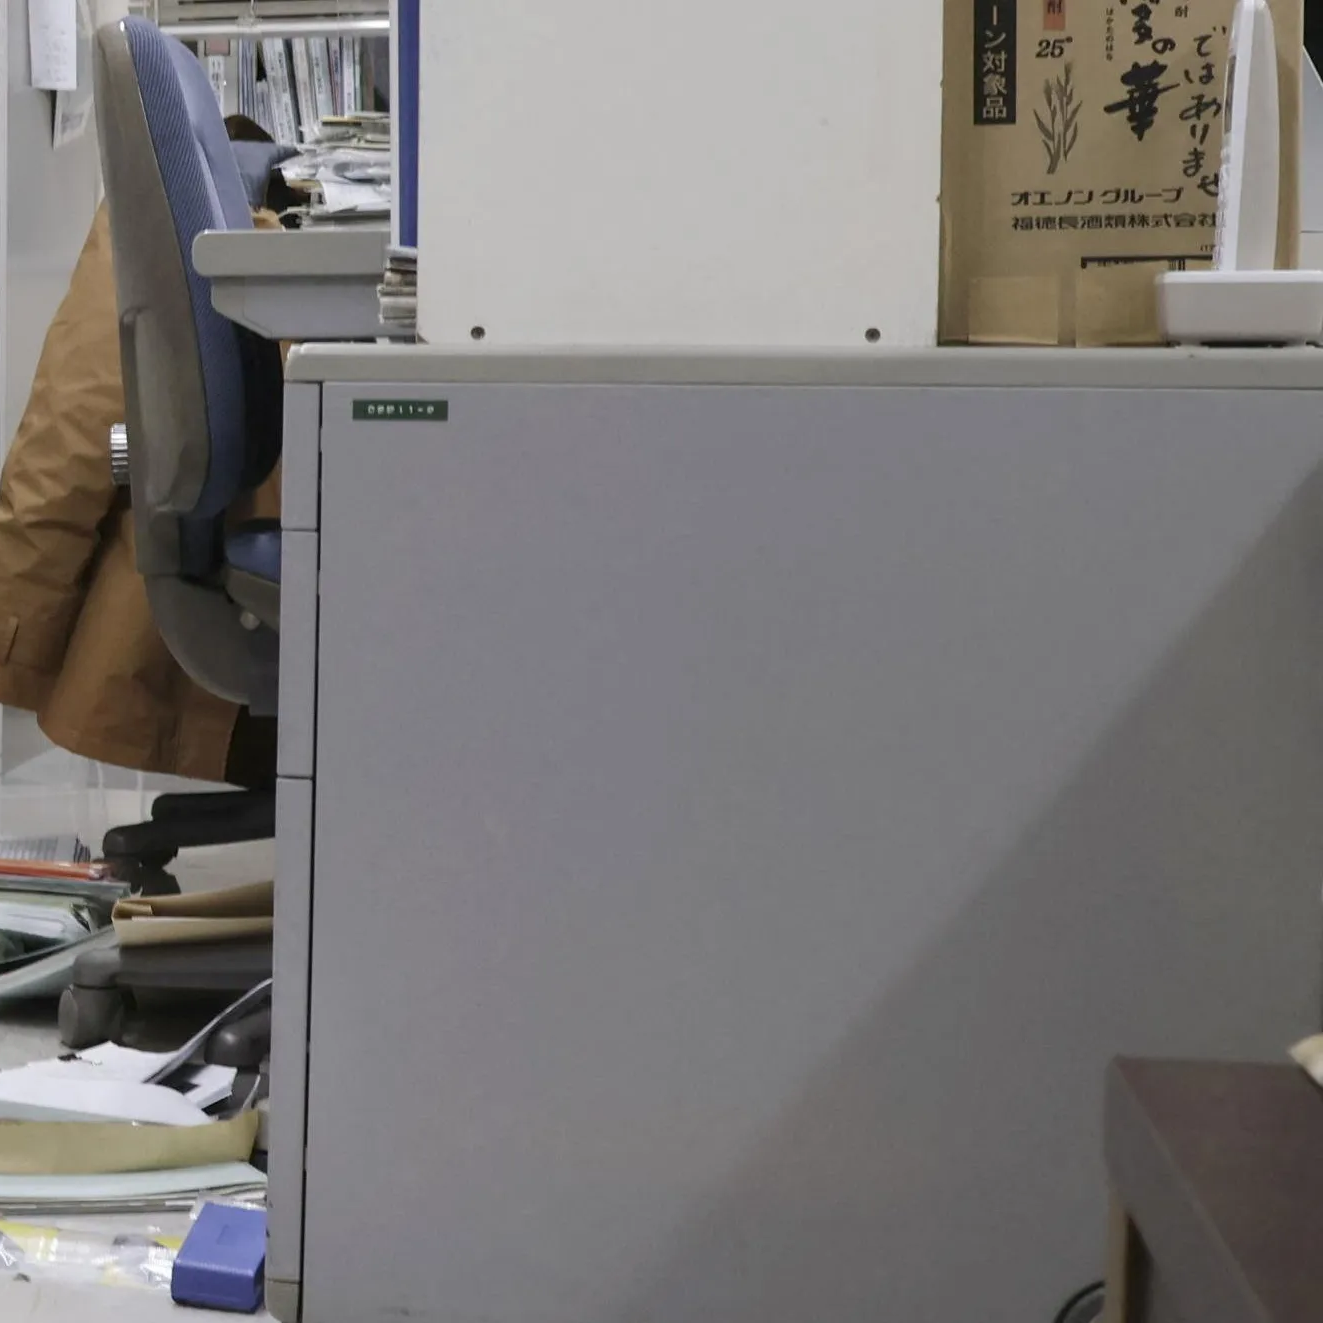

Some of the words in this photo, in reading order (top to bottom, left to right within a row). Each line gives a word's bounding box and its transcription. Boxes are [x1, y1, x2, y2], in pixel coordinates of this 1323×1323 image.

[982, 5, 1007, 118] ーン対象品
[1011, 213, 1217, 231] 福徳長酒類株式会社
